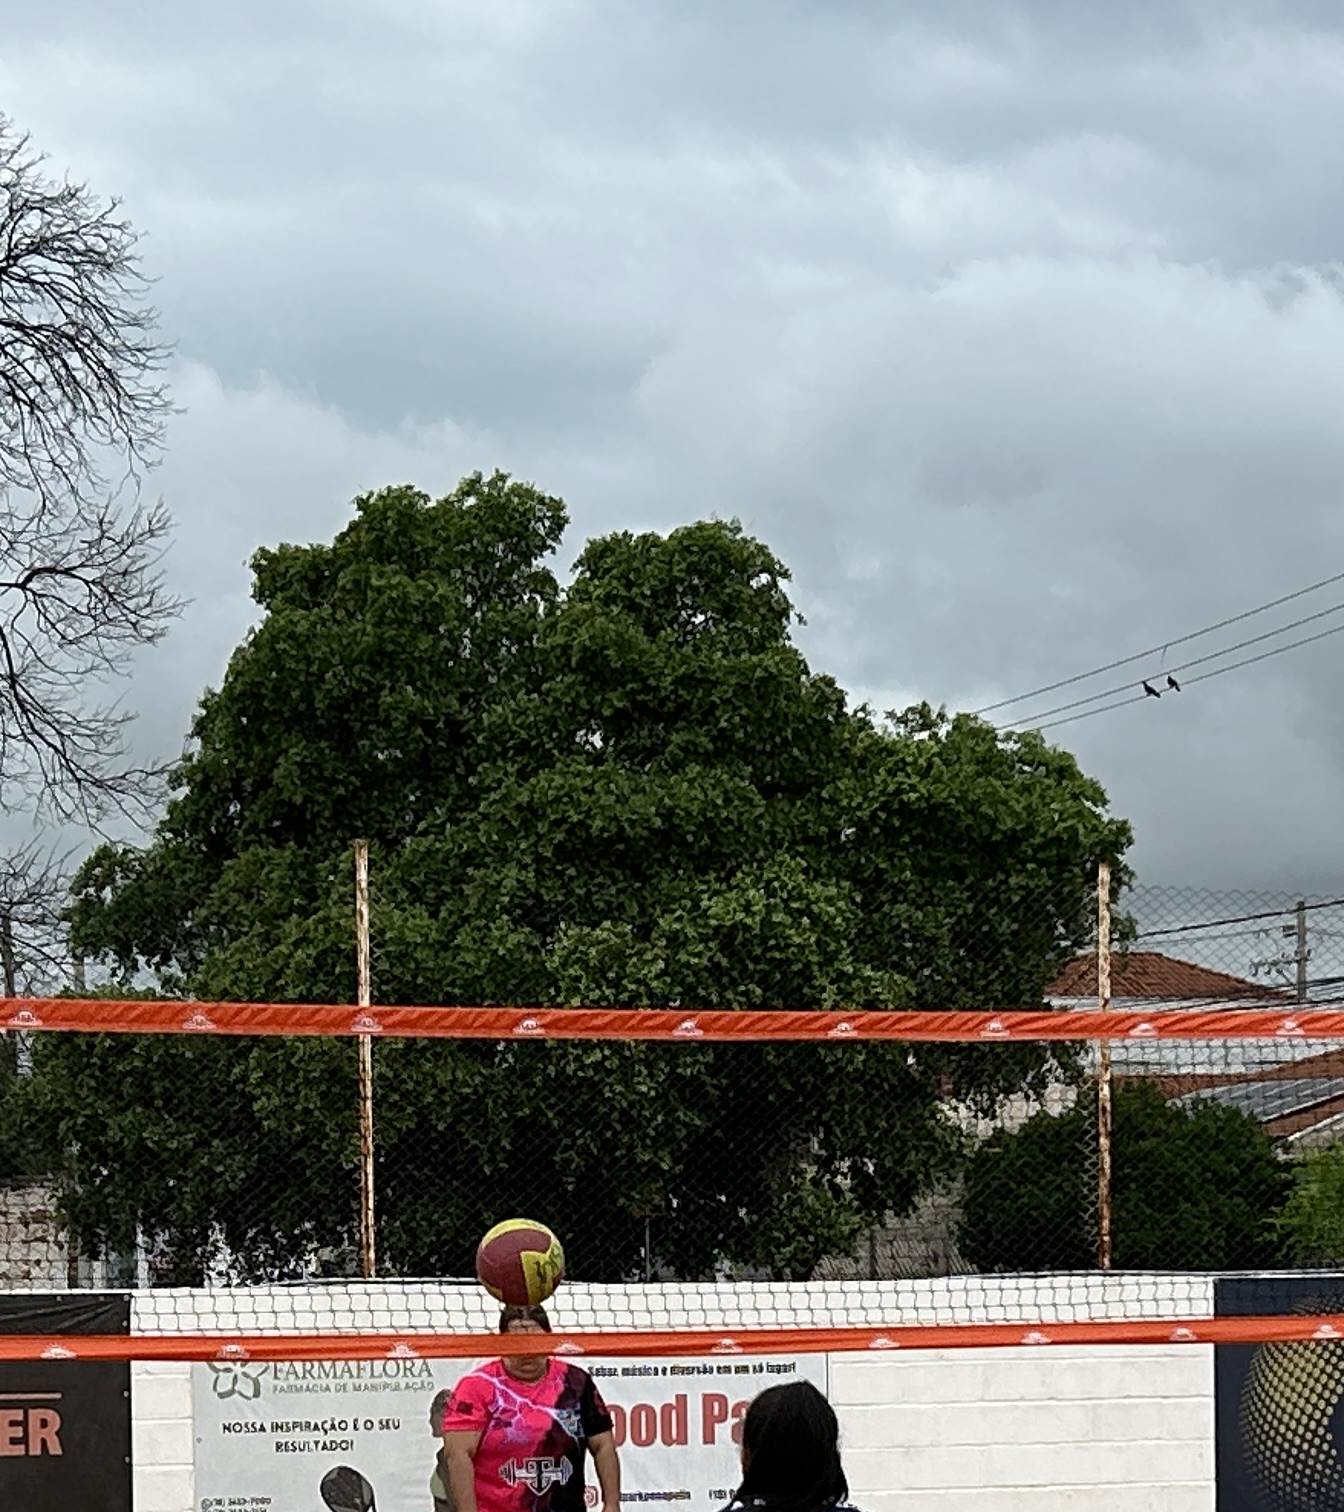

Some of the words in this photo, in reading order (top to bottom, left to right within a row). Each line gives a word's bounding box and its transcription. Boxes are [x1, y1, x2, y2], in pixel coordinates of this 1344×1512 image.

[272, 1360, 433, 1381] FARMAFLORA
[335, 1382, 349, 1393] DE
[222, 1420, 267, 1435] NOSSA
[270, 1417, 349, 1436] INSPIRAÇÃO
[364, 1418, 375, 1431] O
[378, 1417, 401, 1431] SEU
[606, 1393, 689, 1448] ood
[702, 1392, 748, 1447] Pa
[275, 1439, 355, 1454] RESULTADO!
